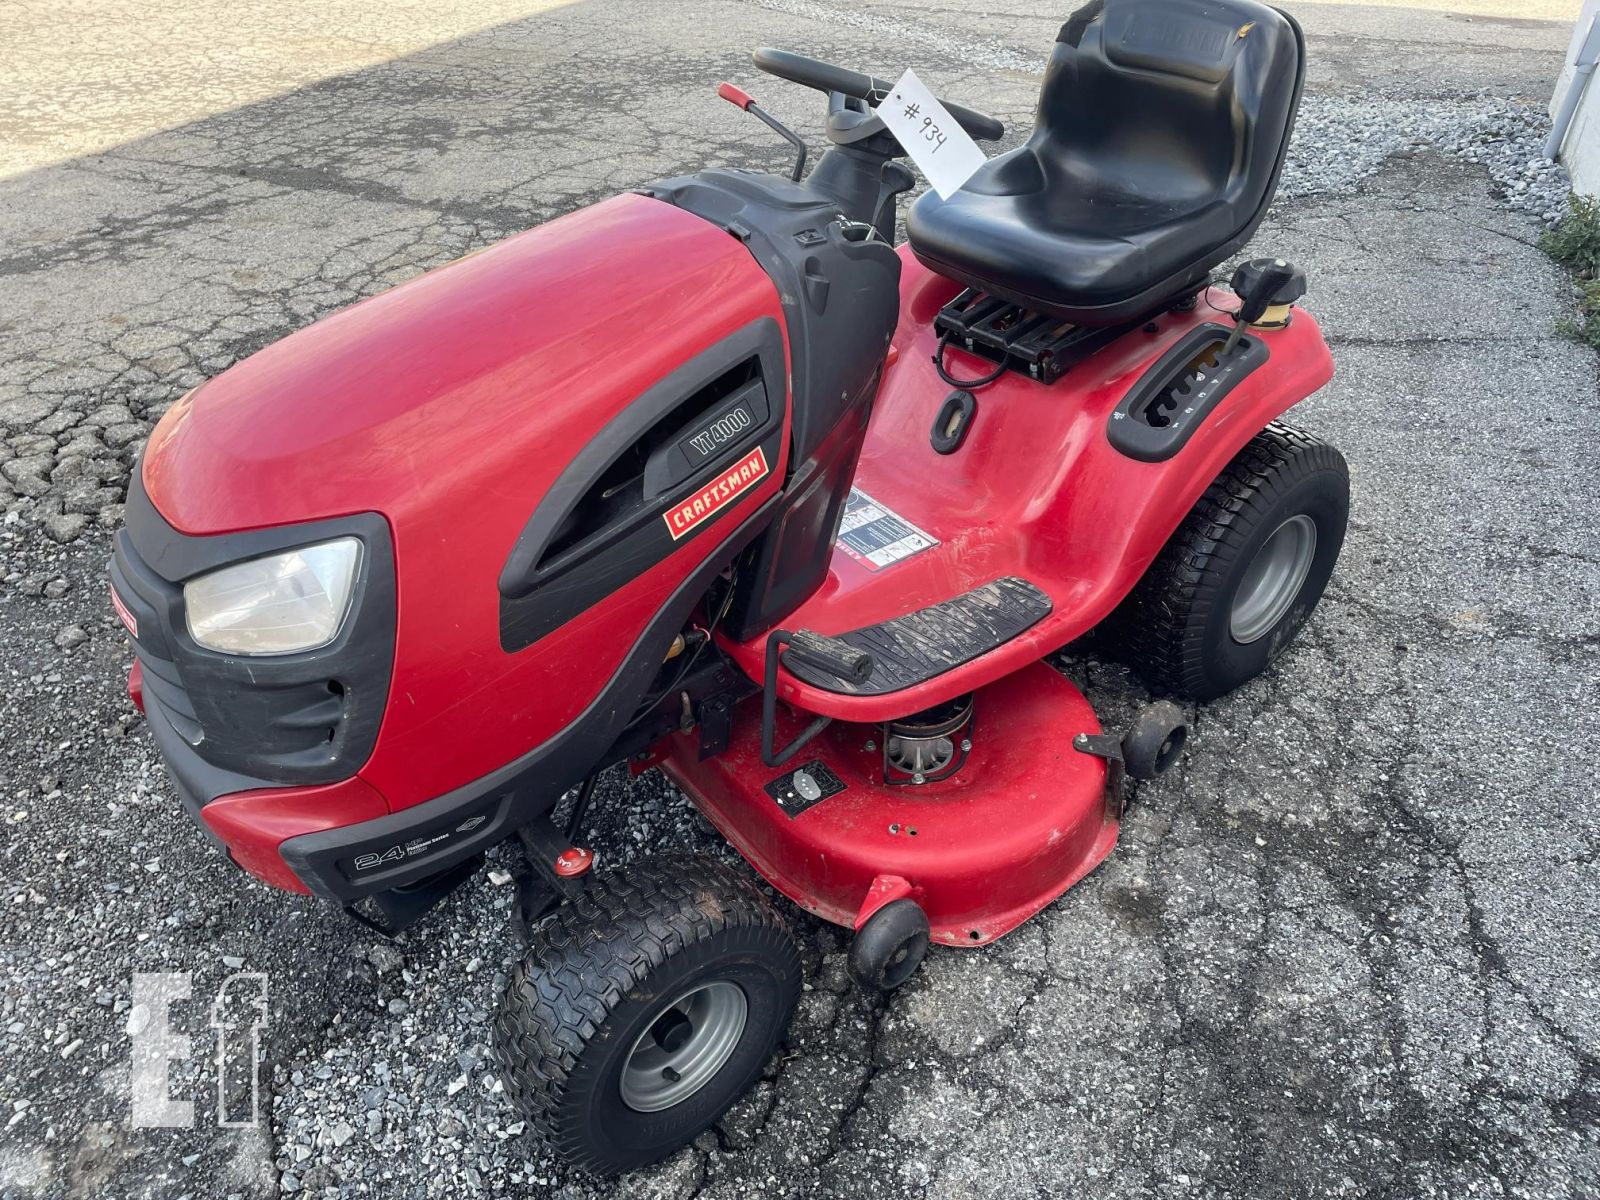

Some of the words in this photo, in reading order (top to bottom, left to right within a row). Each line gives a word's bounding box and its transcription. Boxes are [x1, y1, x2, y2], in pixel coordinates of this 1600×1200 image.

[689, 430, 716, 456] YT
[709, 407, 751, 443] 4000
[673, 456, 762, 529] CRAFTSMAN
[354, 845, 405, 871] 24
